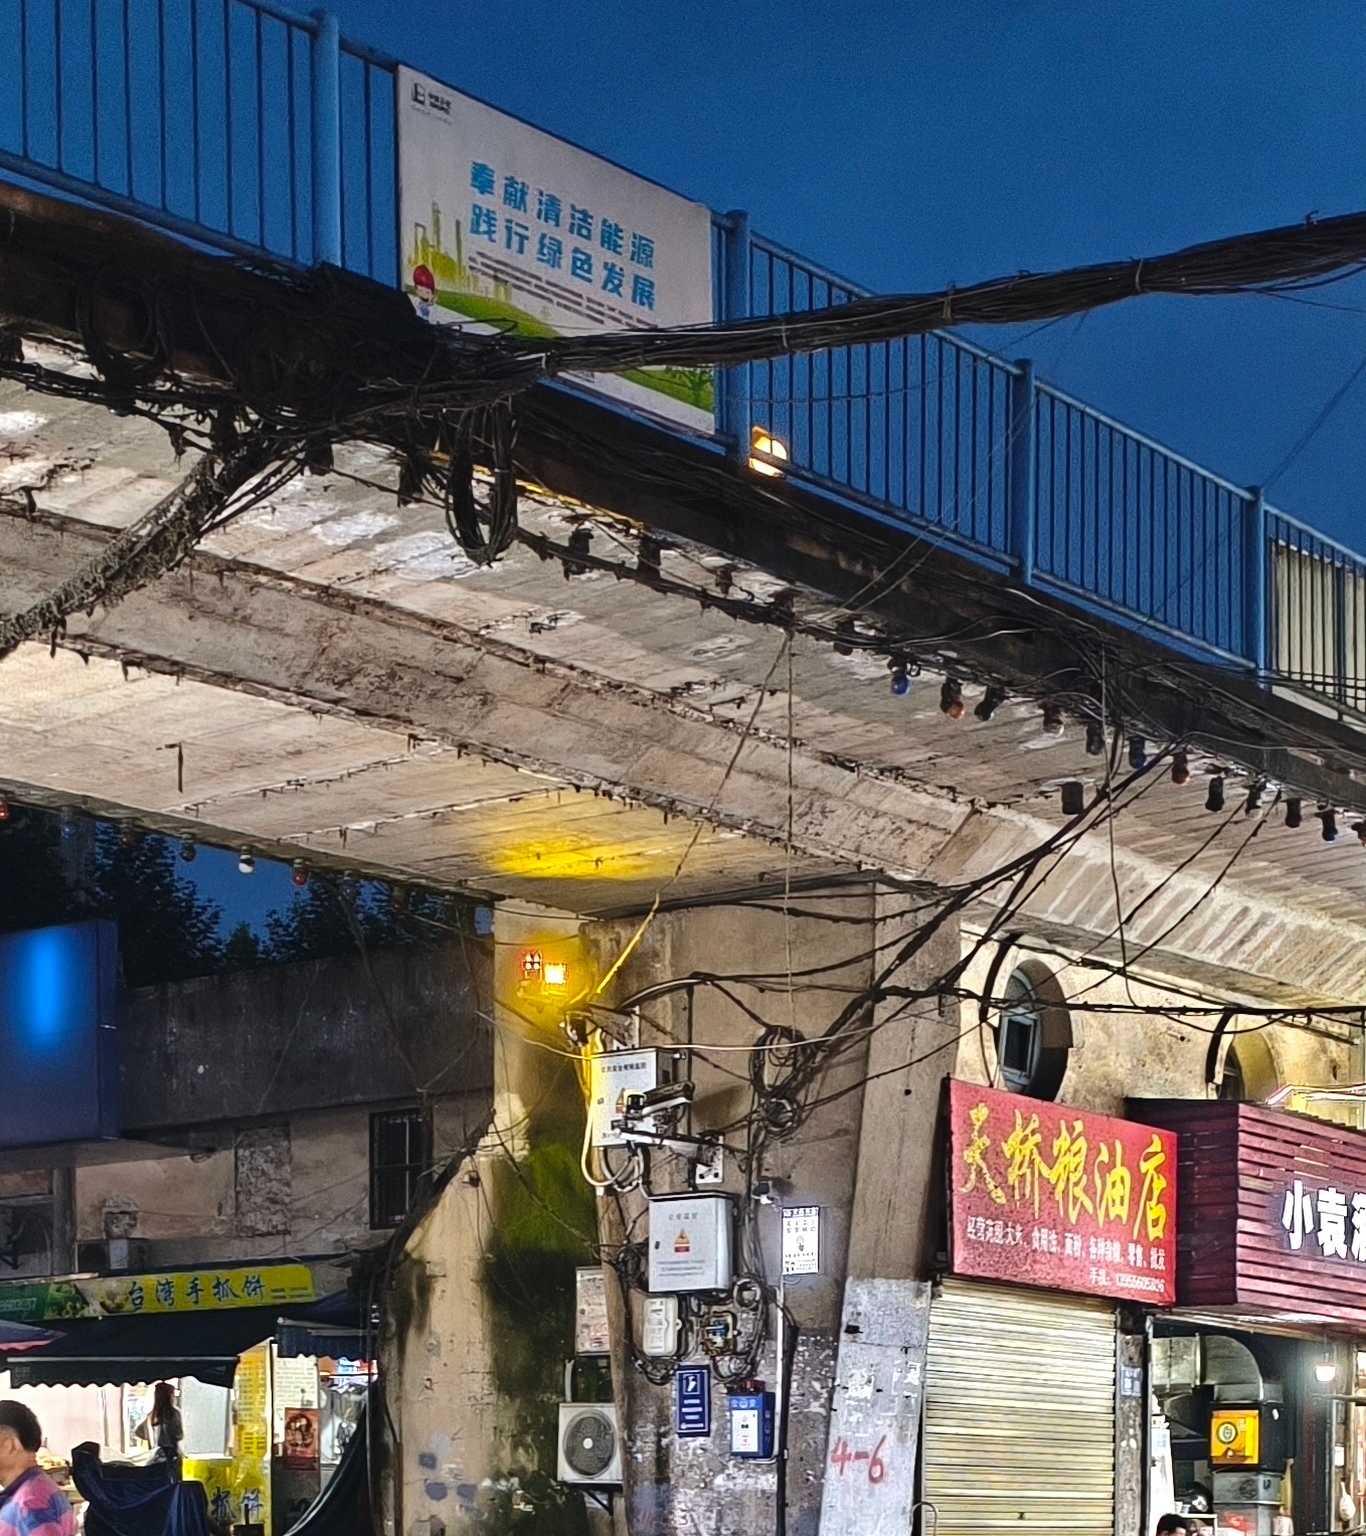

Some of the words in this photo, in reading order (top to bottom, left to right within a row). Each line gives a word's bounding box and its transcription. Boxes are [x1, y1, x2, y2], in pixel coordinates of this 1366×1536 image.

[469, 160, 656, 271] 奉献清洁能源
[469, 203, 656, 312] 践行绿色发展
[961, 1101, 1168, 1242] 天桥粮油店
[128, 1274, 266, 1312] 台湾手抓饼
[830, 1434, 887, 1484] 4-6
